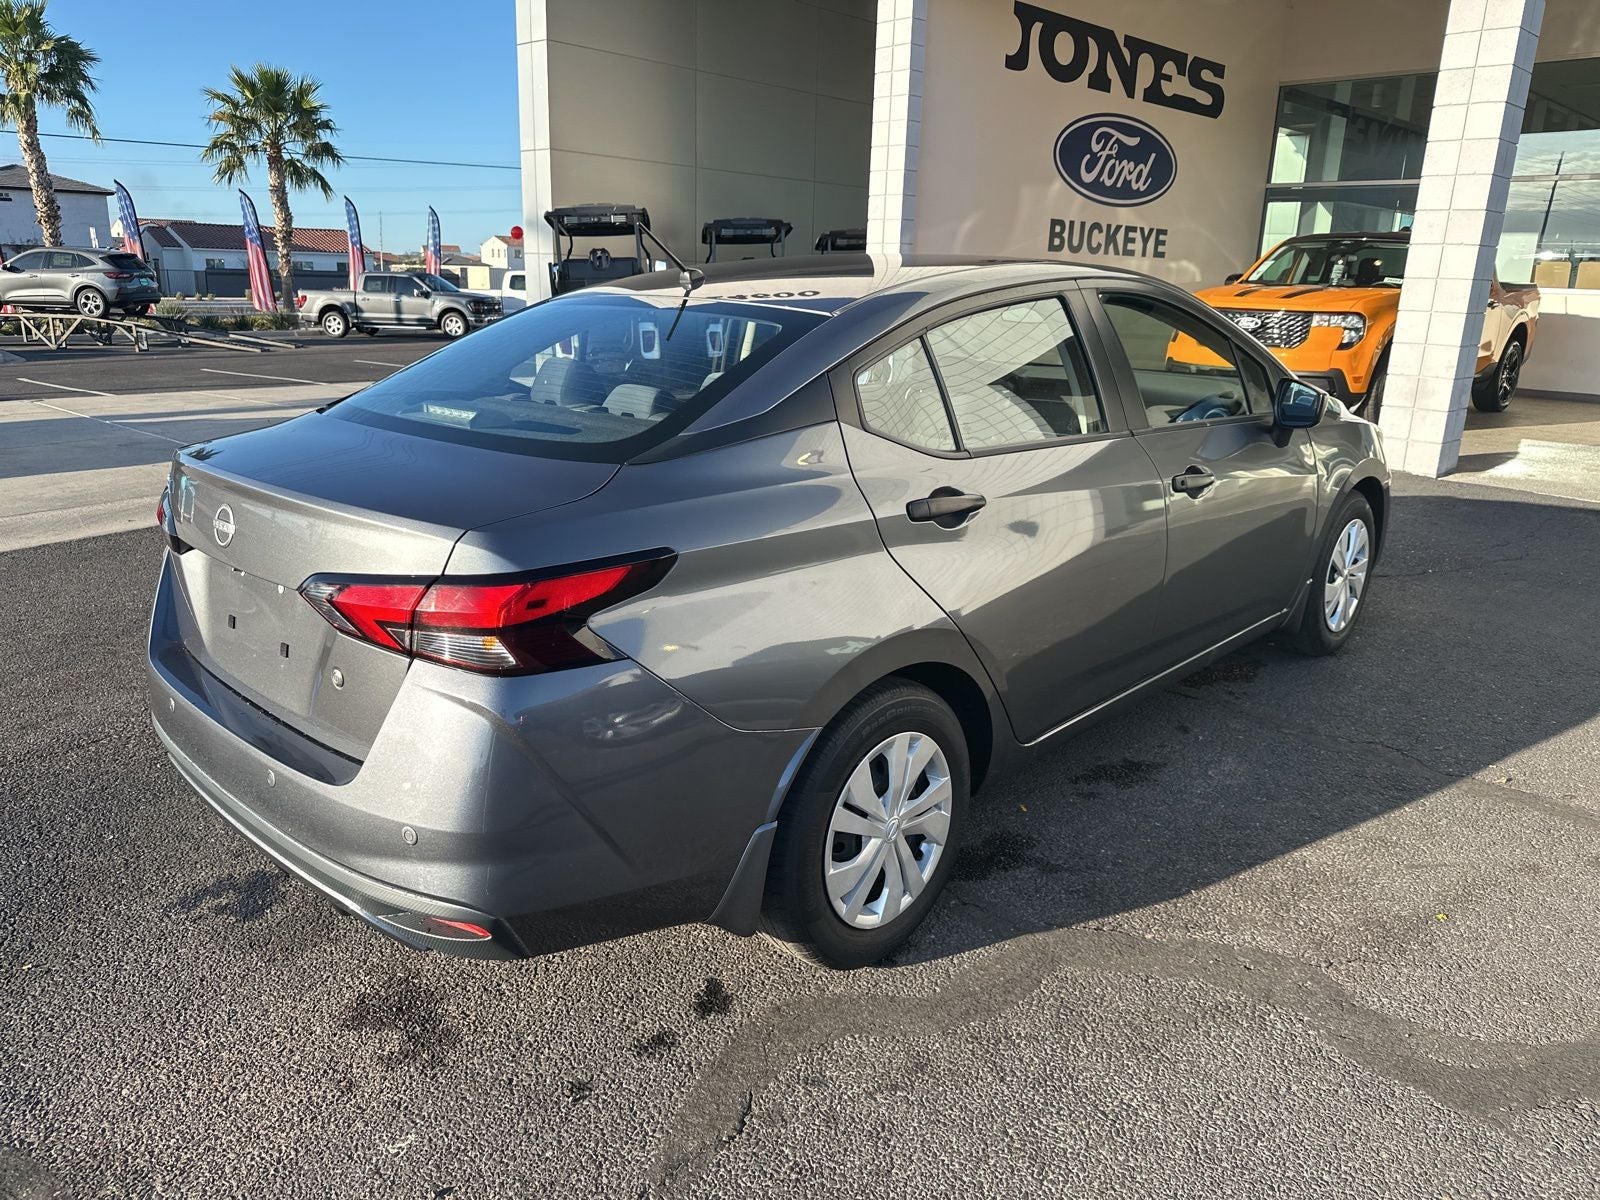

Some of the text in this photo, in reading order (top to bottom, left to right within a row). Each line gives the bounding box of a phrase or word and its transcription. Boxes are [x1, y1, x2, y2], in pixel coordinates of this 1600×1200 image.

[1005, 0, 1226, 119] JONES
[1080, 127, 1156, 191] Ford
[1048, 218, 1169, 258] BUCKEYE
